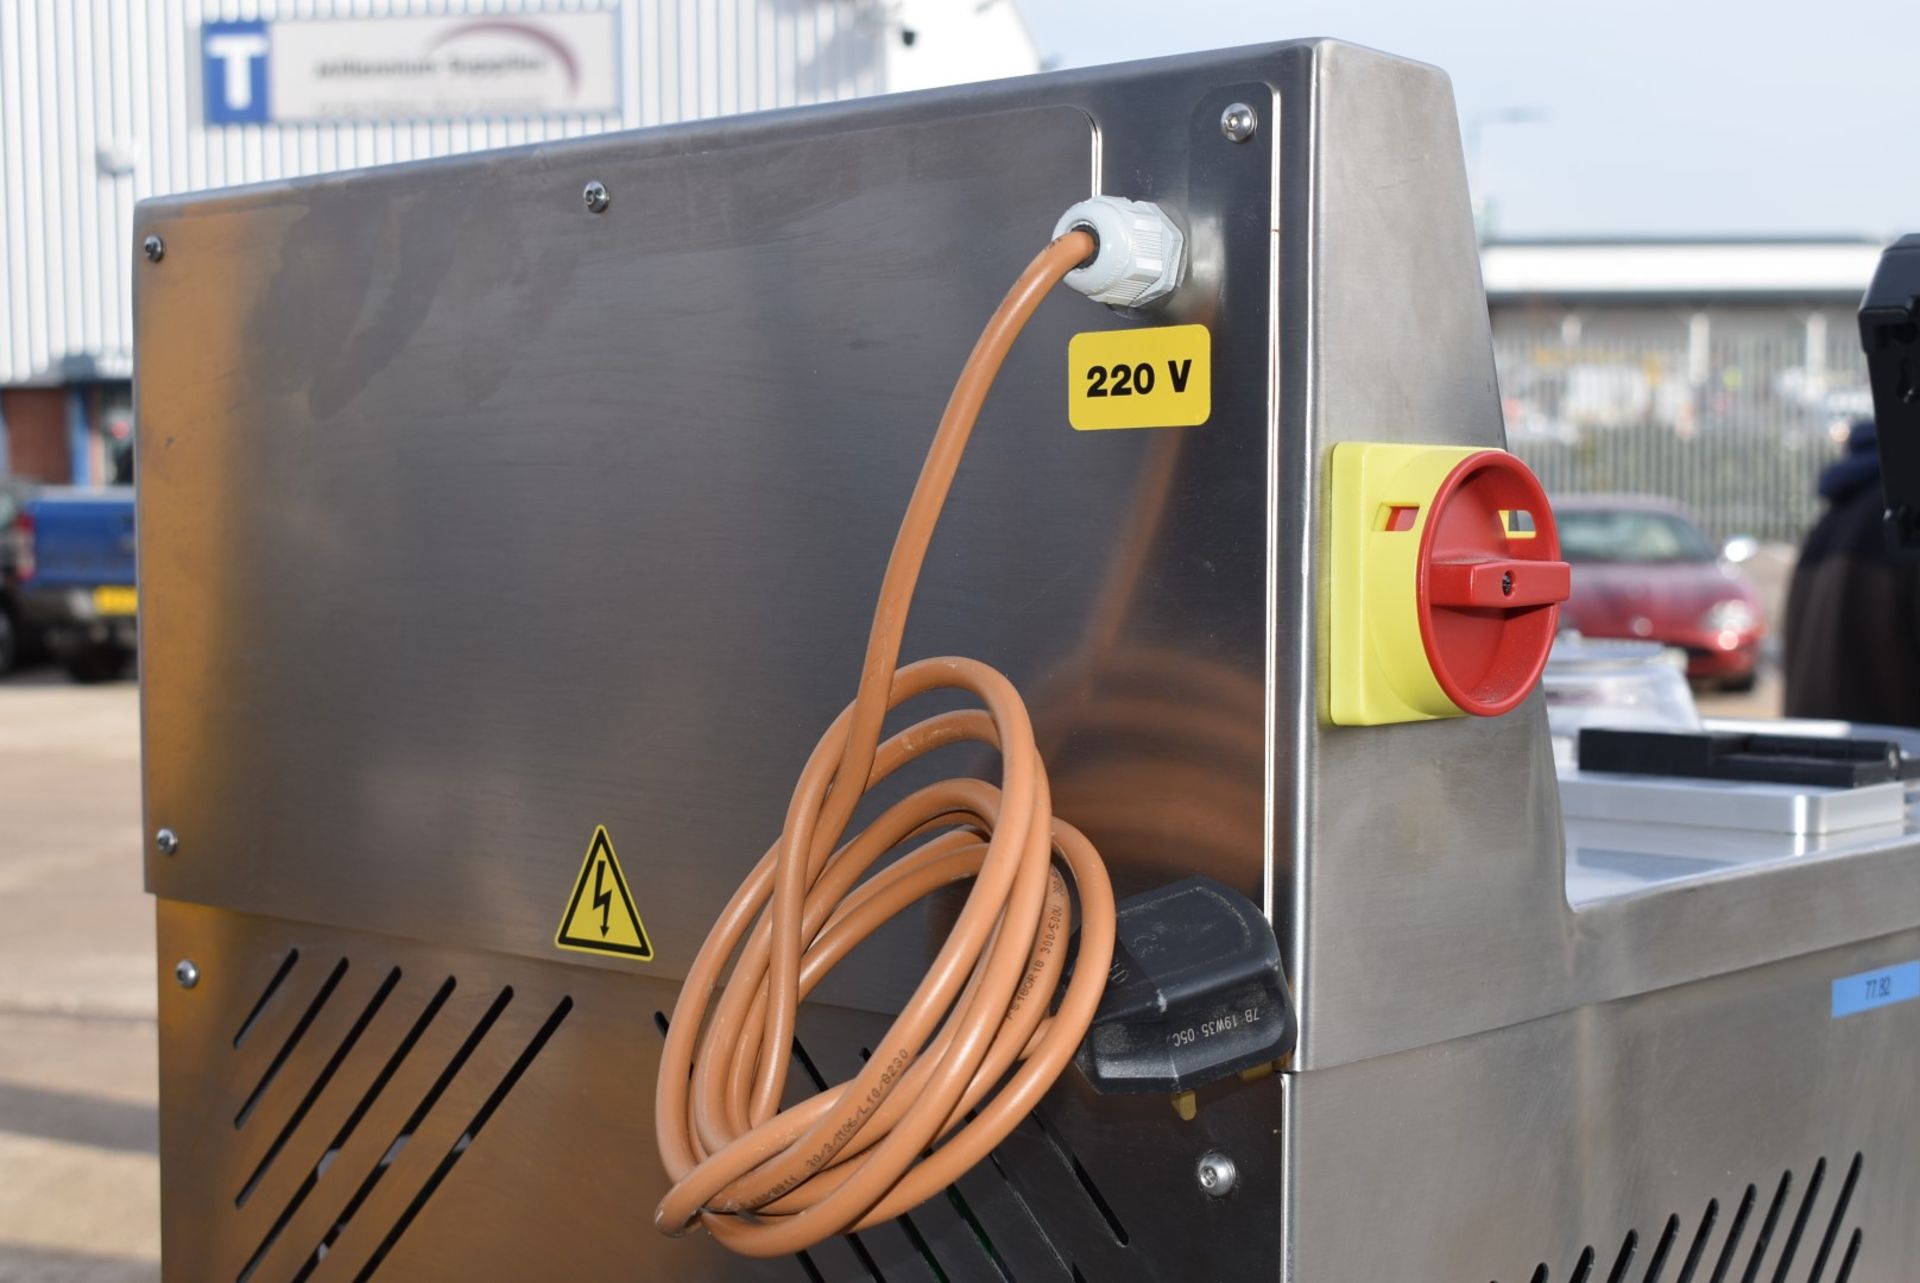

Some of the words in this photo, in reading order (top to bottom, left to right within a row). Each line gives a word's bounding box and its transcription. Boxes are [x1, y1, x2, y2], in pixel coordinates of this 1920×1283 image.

[1087, 362, 1155, 398] 220
[1167, 359, 1192, 393] V
[1201, 1011, 1238, 1038] 19W35
[1244, 1007, 1260, 1023] 7B
